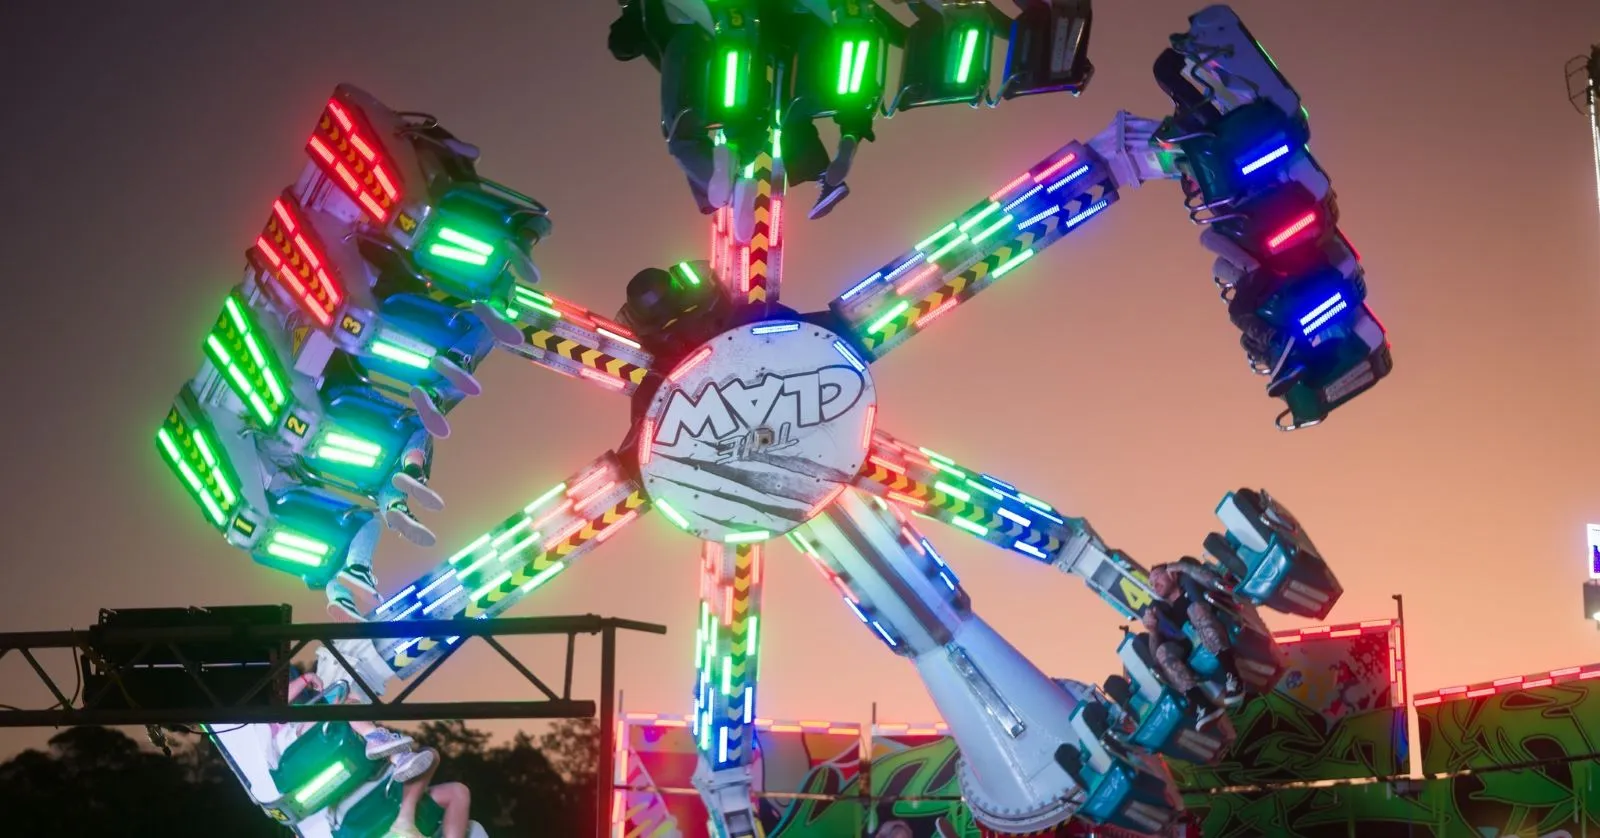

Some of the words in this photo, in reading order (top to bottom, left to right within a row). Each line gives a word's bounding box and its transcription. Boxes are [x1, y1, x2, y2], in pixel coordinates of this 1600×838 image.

[399, 212, 418, 232] 4
[342, 315, 362, 334] 3
[651, 364, 865, 448] CLAW
[287, 415, 306, 436] 2
[235, 517, 253, 534] 1
[1119, 576, 1153, 612] 4
